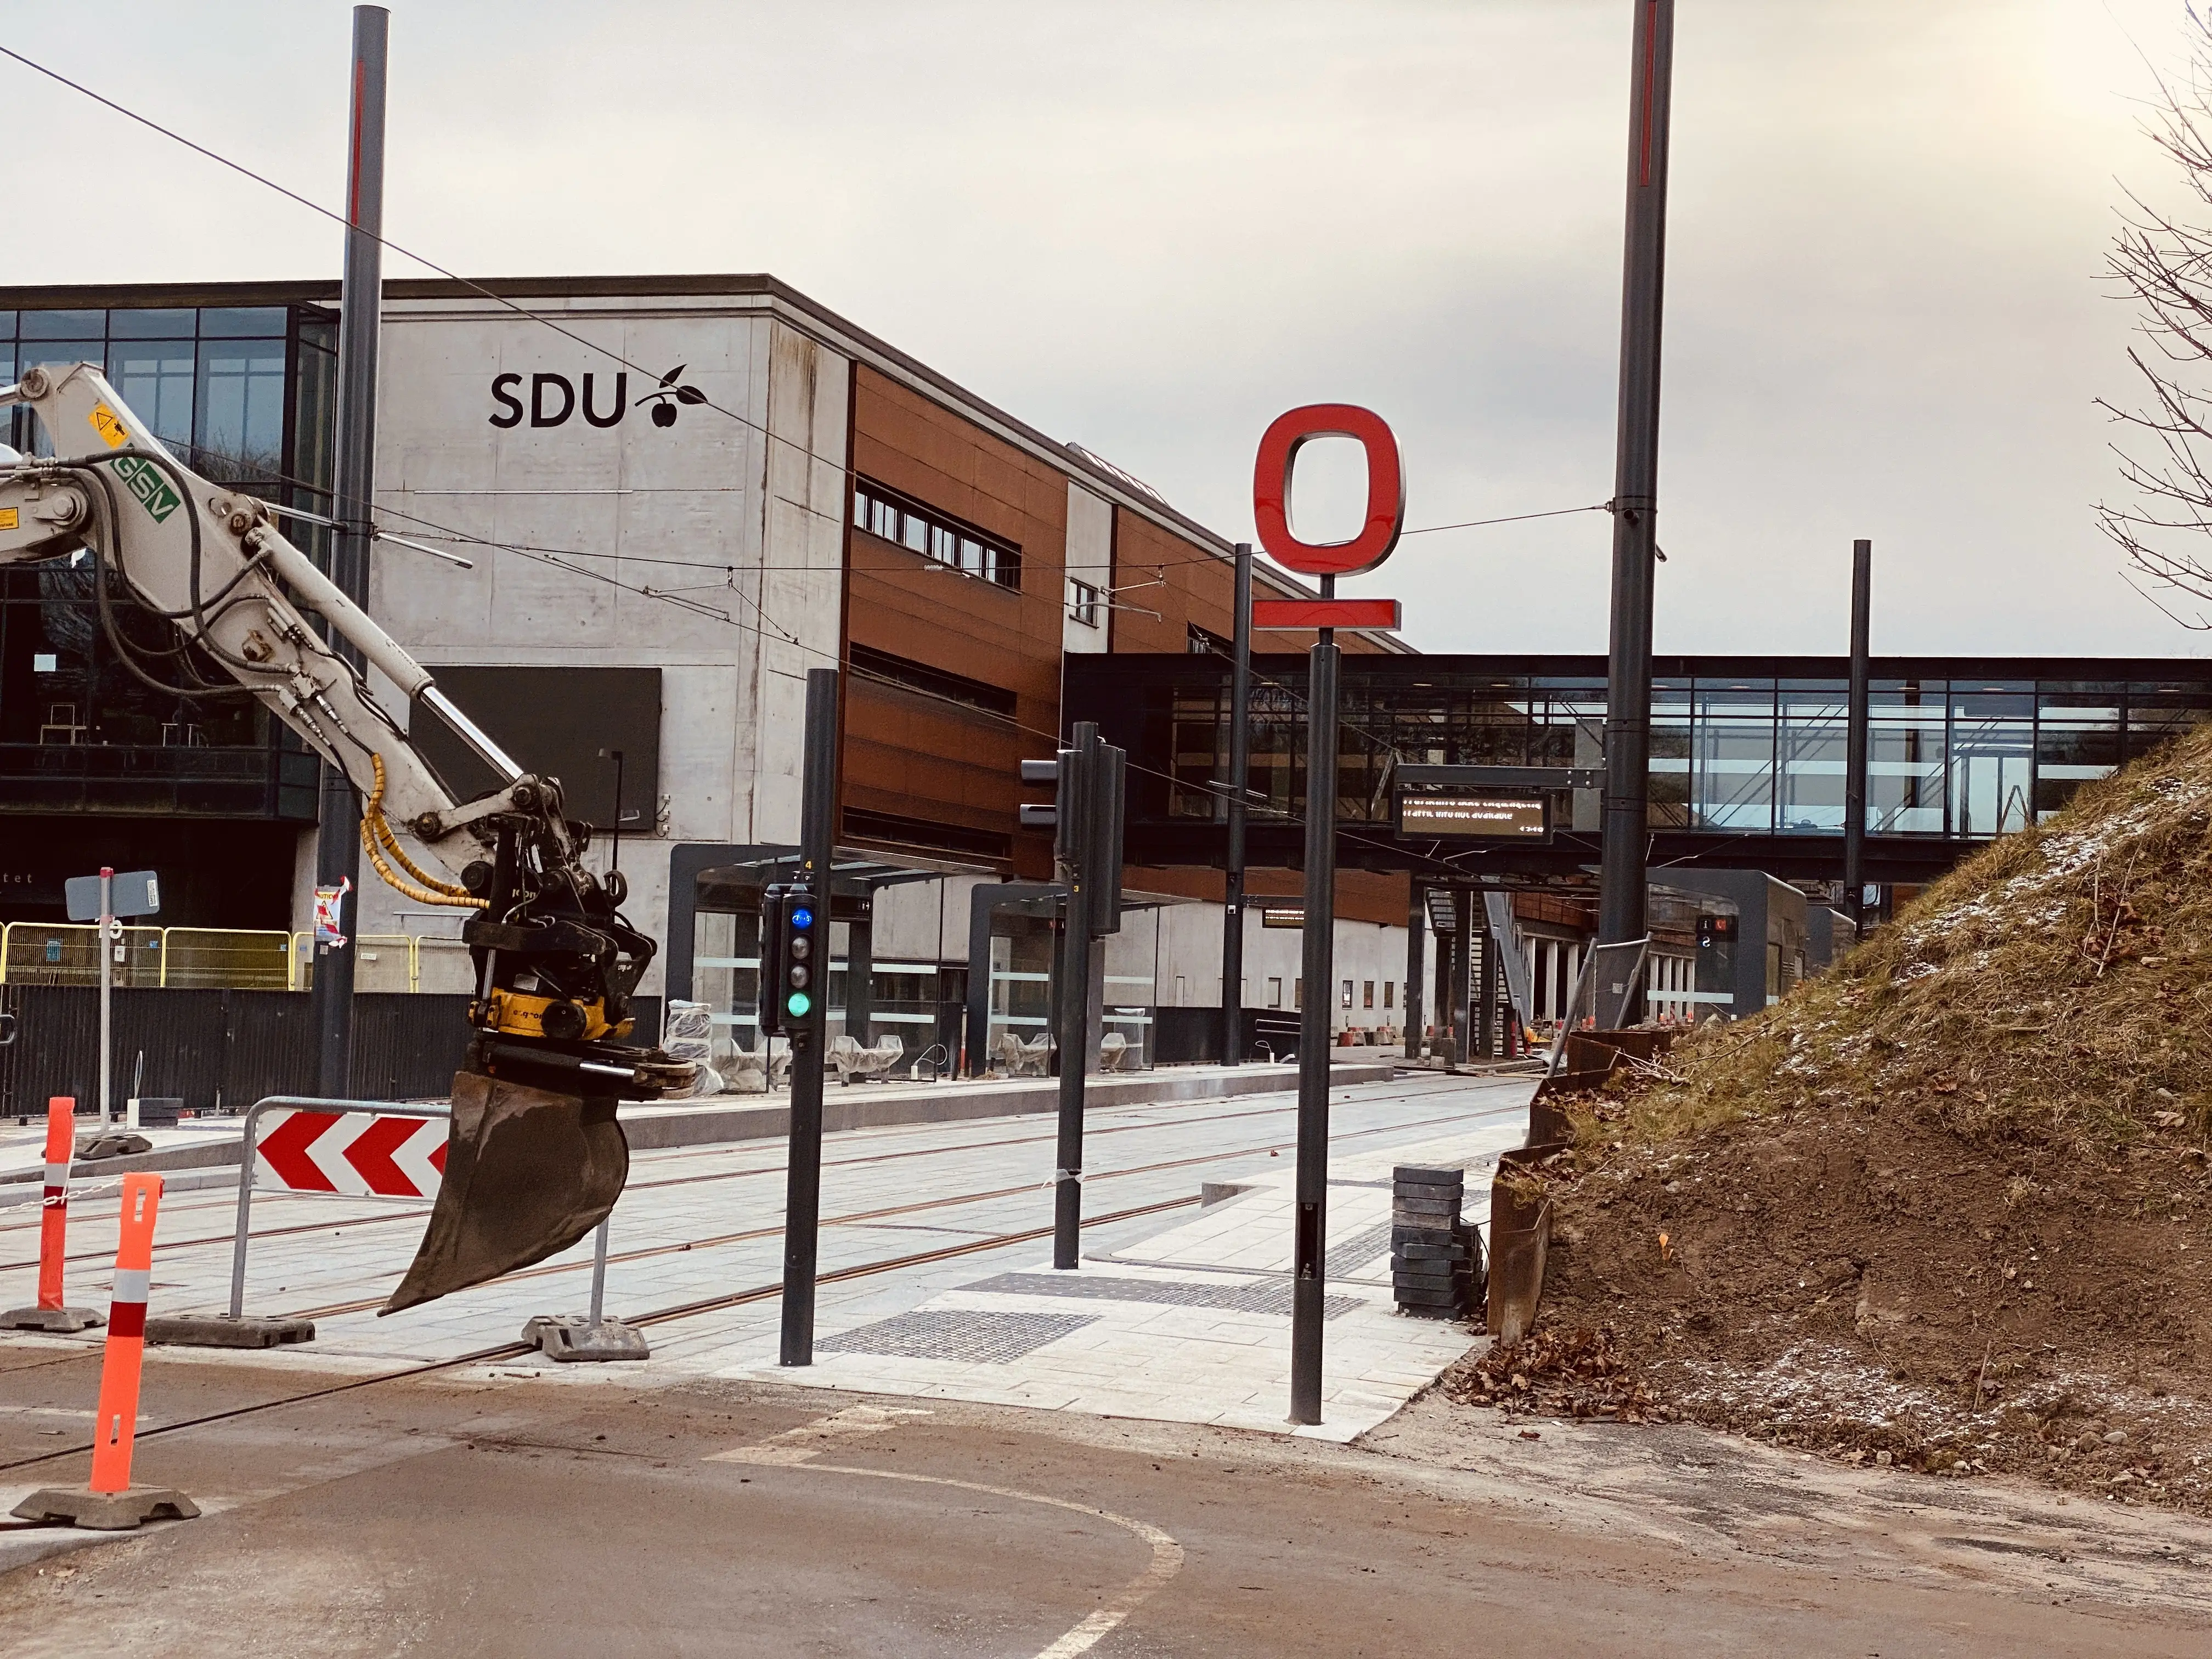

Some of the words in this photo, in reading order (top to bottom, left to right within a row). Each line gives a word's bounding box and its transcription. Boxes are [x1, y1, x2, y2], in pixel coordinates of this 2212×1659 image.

[488, 373, 627, 428] SDU
[114, 456, 174, 516] GSV
[805, 861, 812, 869] 4
